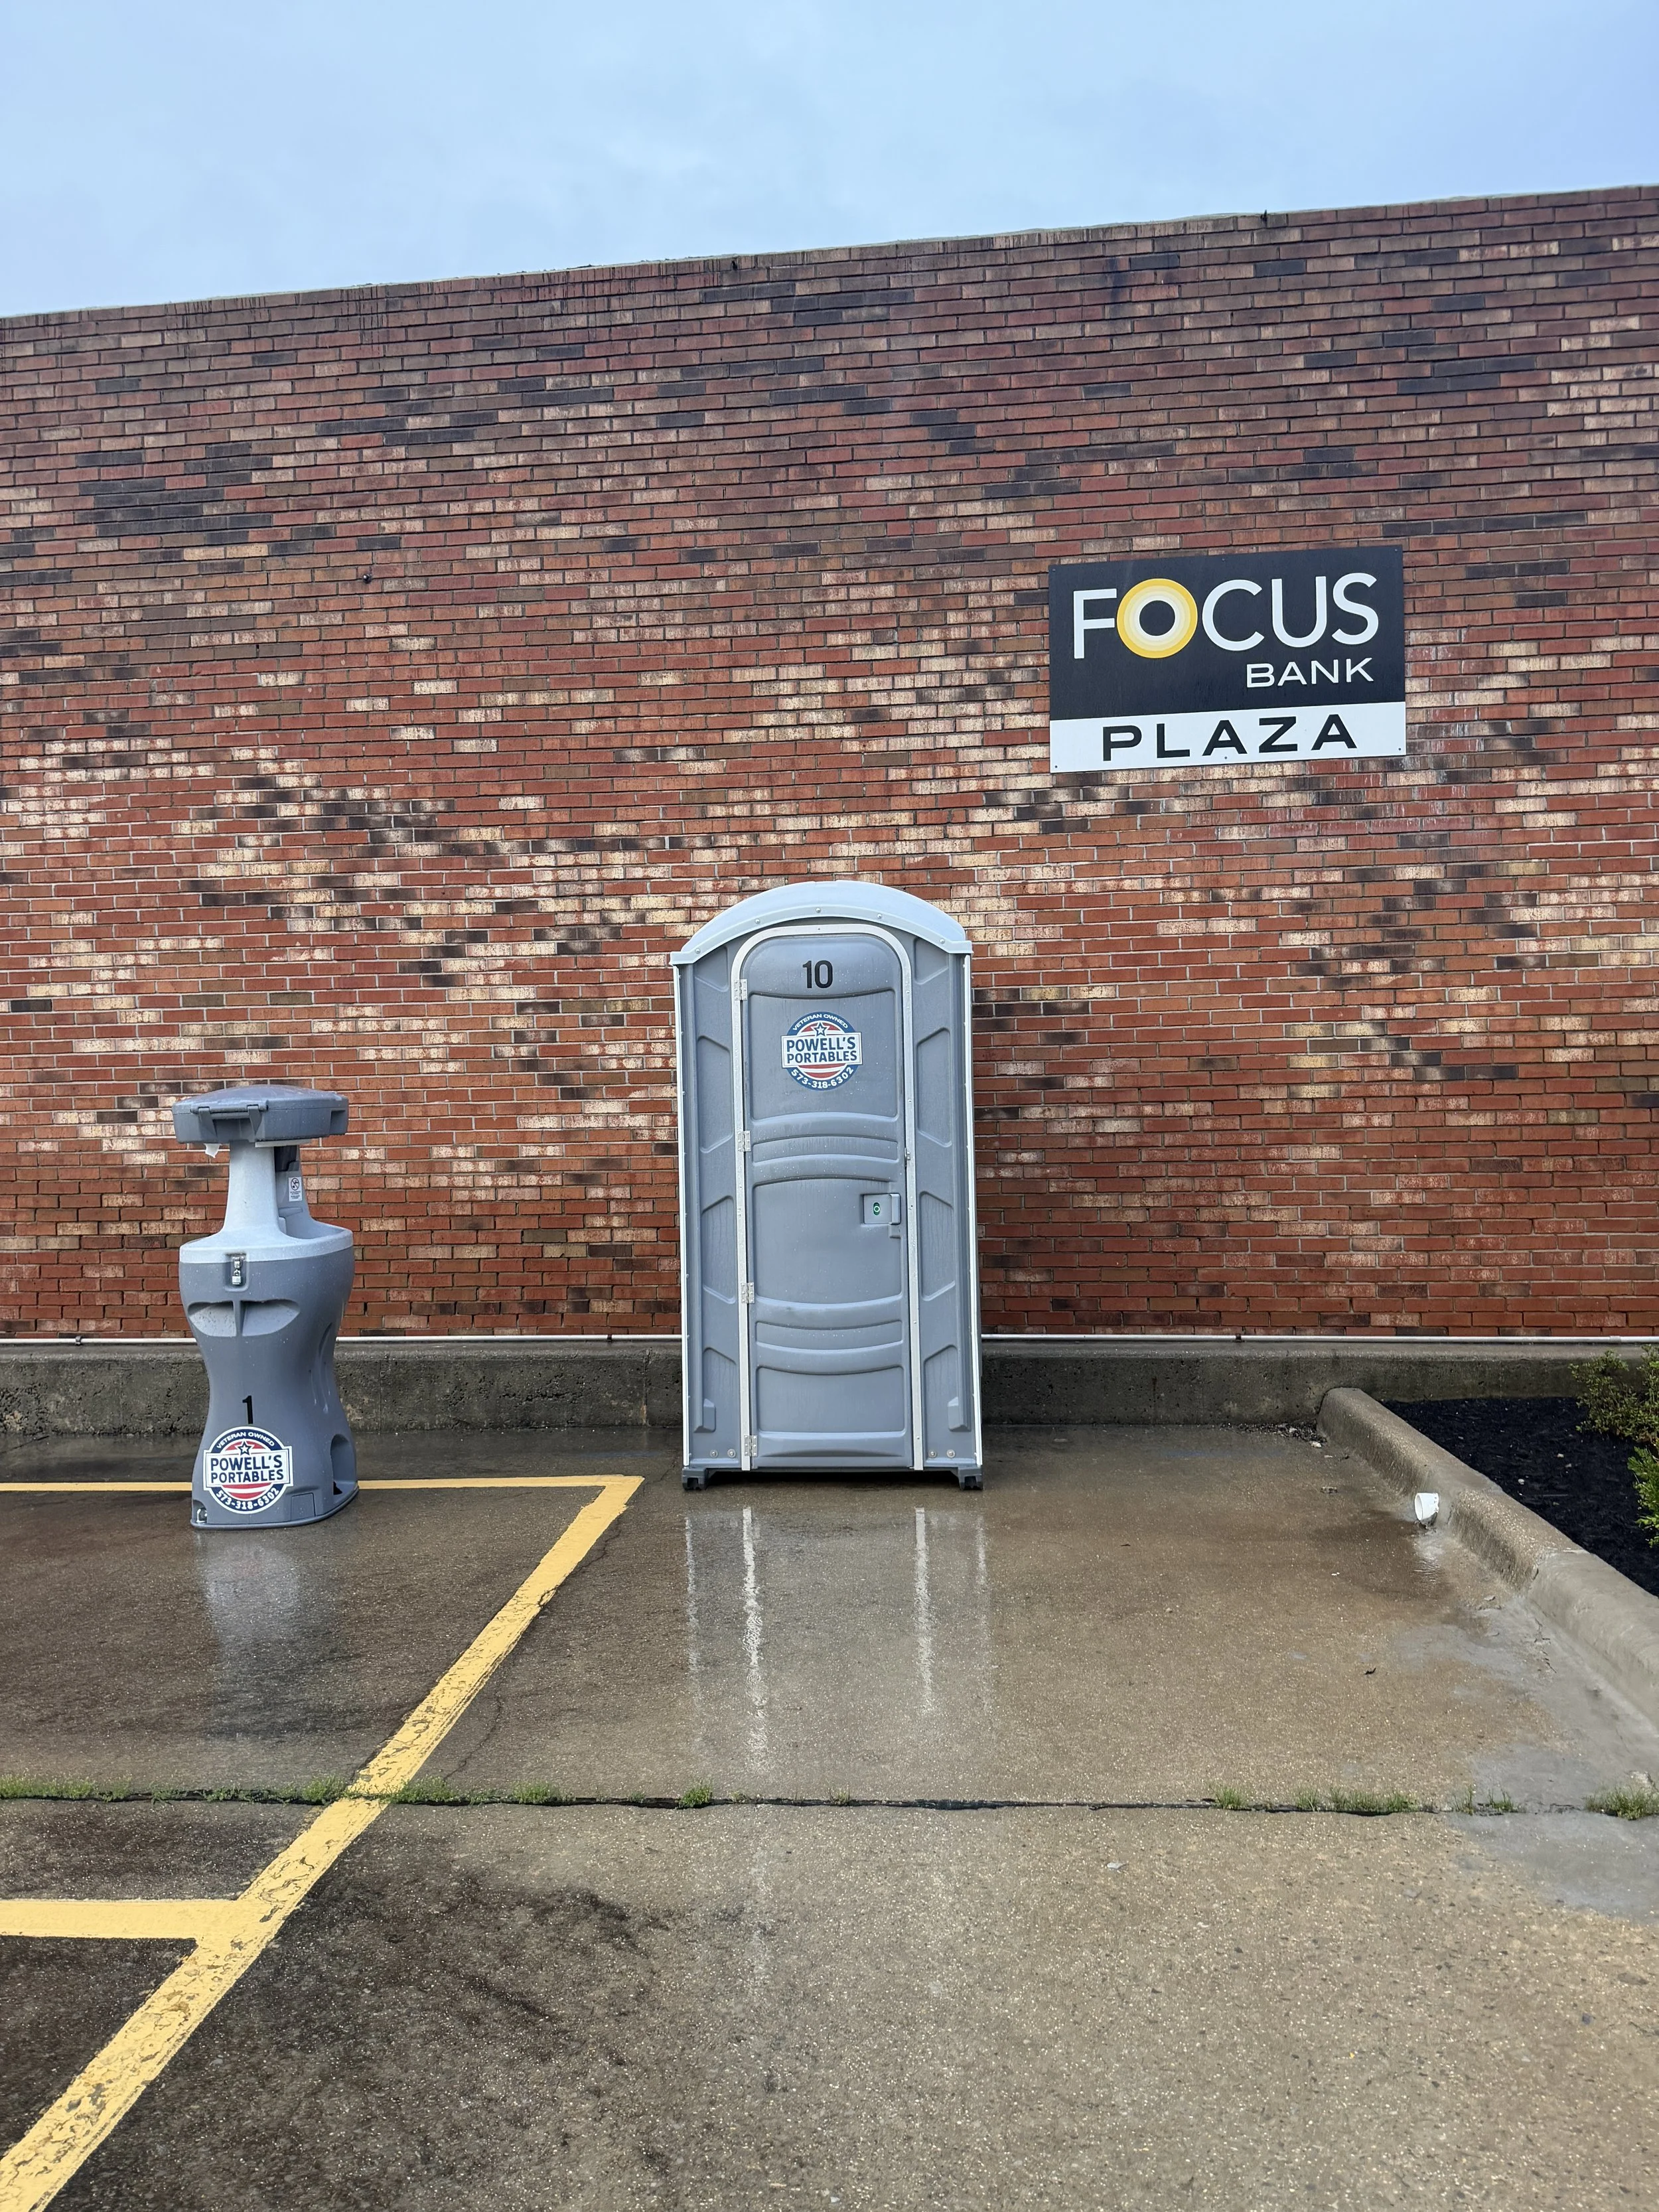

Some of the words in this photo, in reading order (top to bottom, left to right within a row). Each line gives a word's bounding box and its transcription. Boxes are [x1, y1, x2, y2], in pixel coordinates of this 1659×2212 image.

[1073, 572, 1379, 659] FOCUS
[1246, 657, 1374, 688] BANK
[1102, 713, 1357, 761] PLAZA
[802, 960, 833, 988] 10
[792, 1014, 822, 1031] VETERAN
[823, 1013, 849, 1029] OWNED
[786, 1037, 856, 1052] POWELL'S
[787, 1051, 857, 1064] PORTABLES
[791, 1067, 854, 1088] 573-318-6302
[242, 1395, 253, 1424] 1
[216, 1432, 246, 1449] VETERAN
[248, 1432, 275, 1447] OWNED
[210, 1455, 283, 1471] POWELL'S
[211, 1469, 284, 1483] PORTABLES
[216, 1487, 279, 1510] 573-318-6302
